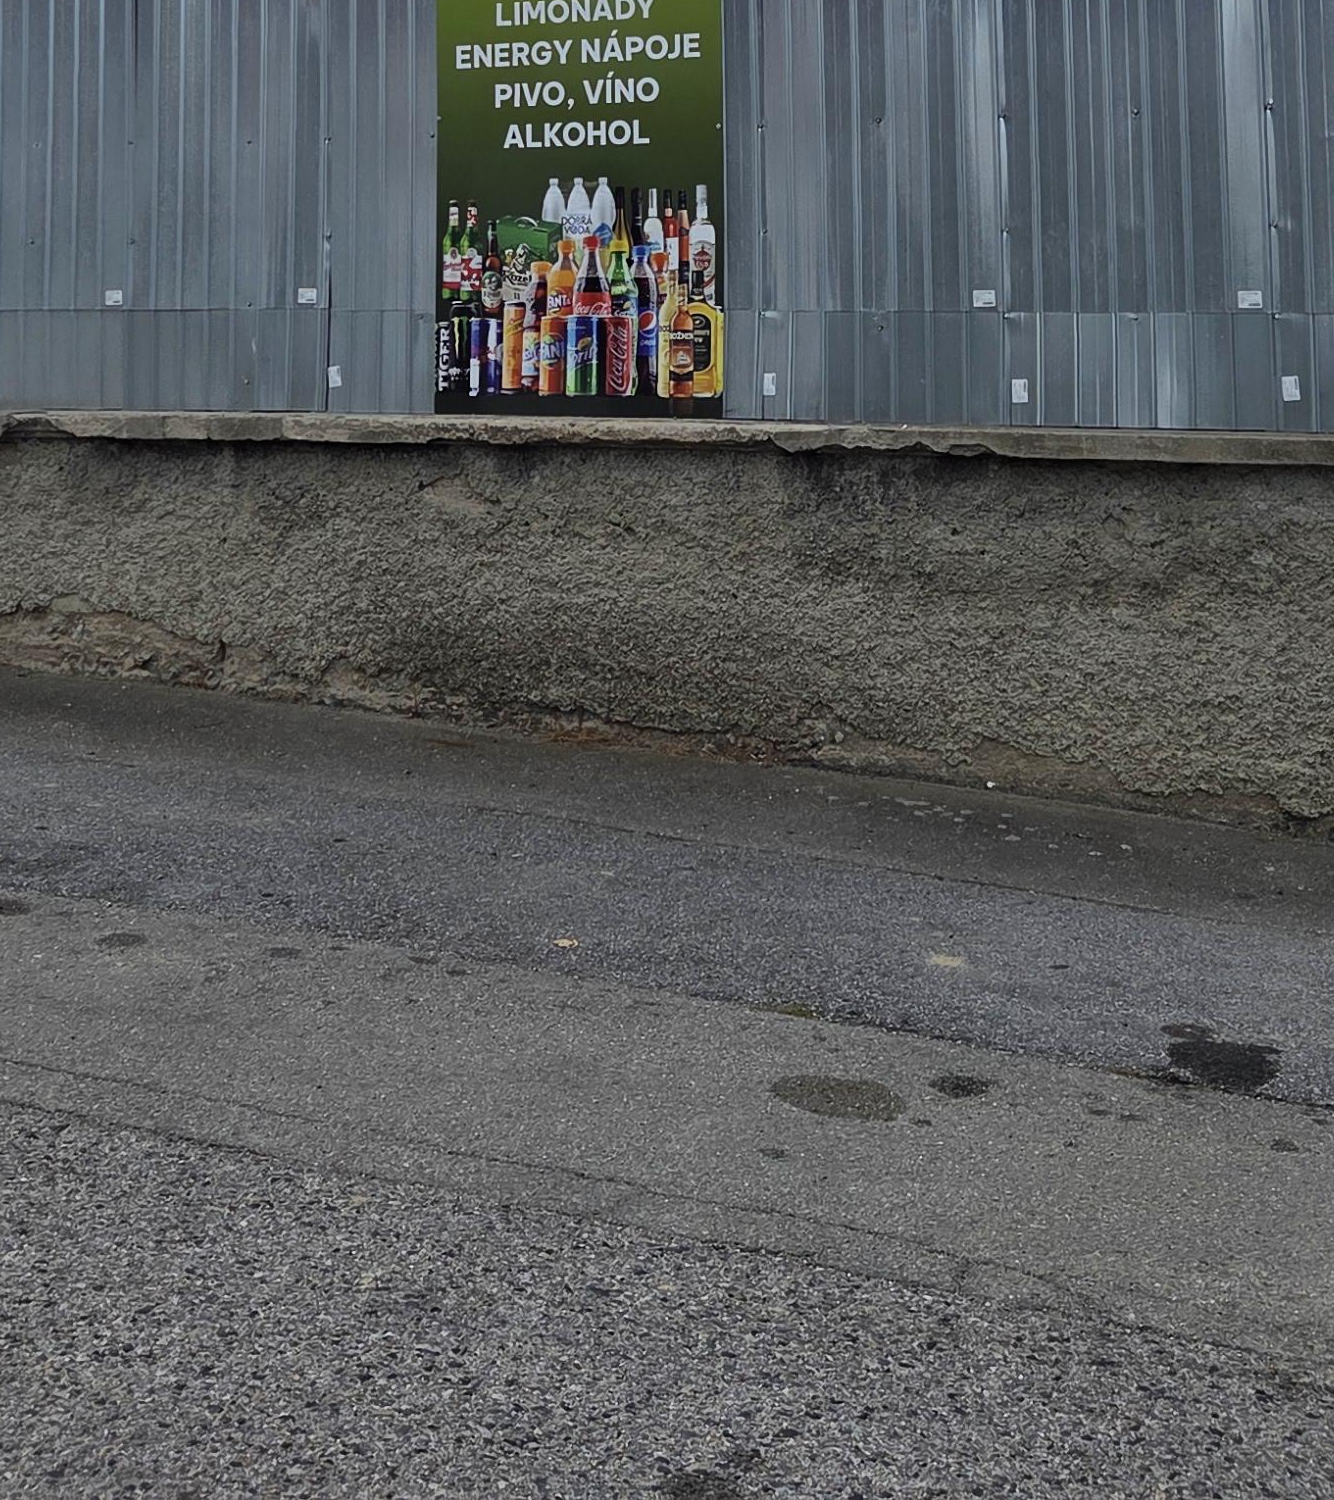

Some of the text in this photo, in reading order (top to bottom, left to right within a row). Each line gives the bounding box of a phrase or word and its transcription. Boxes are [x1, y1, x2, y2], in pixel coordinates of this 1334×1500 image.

[455, 30, 701, 70] ENERGY NÁPOJE
[494, 71, 660, 111] PIVO, VÍNO
[503, 119, 651, 149] ALKOHOL
[438, 328, 451, 391] TIGER
